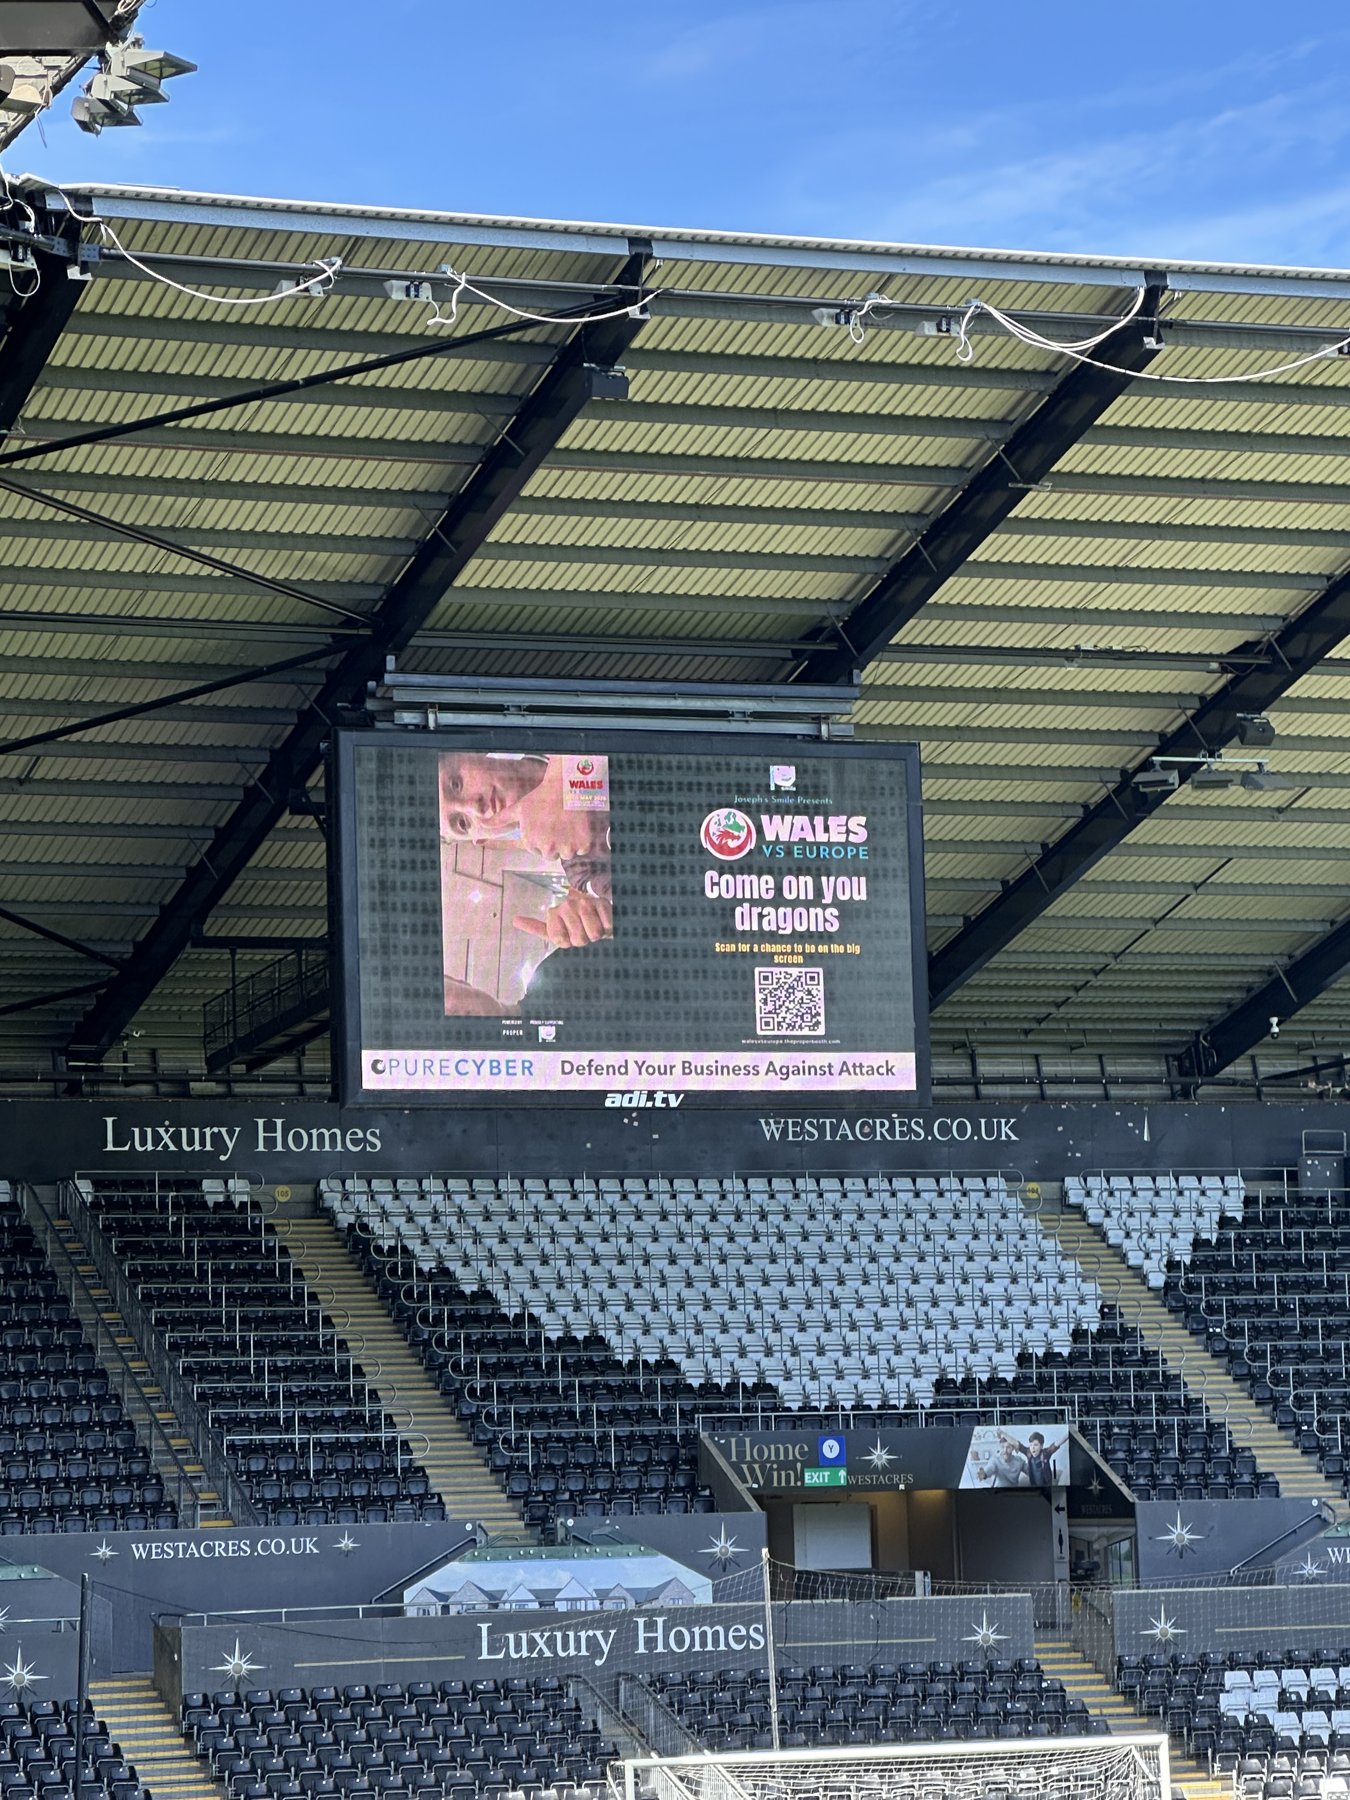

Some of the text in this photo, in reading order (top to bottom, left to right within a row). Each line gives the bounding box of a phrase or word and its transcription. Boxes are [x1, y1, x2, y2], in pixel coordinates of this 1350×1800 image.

[569, 780, 603, 789] WALES
[771, 795, 795, 804] Smile
[797, 796, 833, 805] Presents
[760, 814, 868, 844] WALES
[762, 845, 869, 860] VS EUROPE
[704, 870, 868, 904] Come on you
[735, 903, 840, 934] dragons
[715, 942, 861, 955] Scan for a chance to be on the big
[773, 955, 804, 964] screen
[388, 1058, 534, 1077] PURECYBER
[561, 1059, 896, 1081] Defend Your Business Against Attack
[604, 1090, 685, 1108] adi.tv
[102, 1116, 382, 1161] Luxury Homes
[759, 1118, 1019, 1142] WESTACRES.CO.UK
[729, 1437, 810, 1462] Home
[828, 1444, 835, 1454] Y
[739, 1462, 802, 1490] Win!
[805, 1471, 831, 1484] EXIT
[848, 1474, 914, 1485] WESTACRES
[131, 1537, 320, 1560] WESTACRES.CO.UK
[477, 1616, 765, 1666] Luxury Homes
